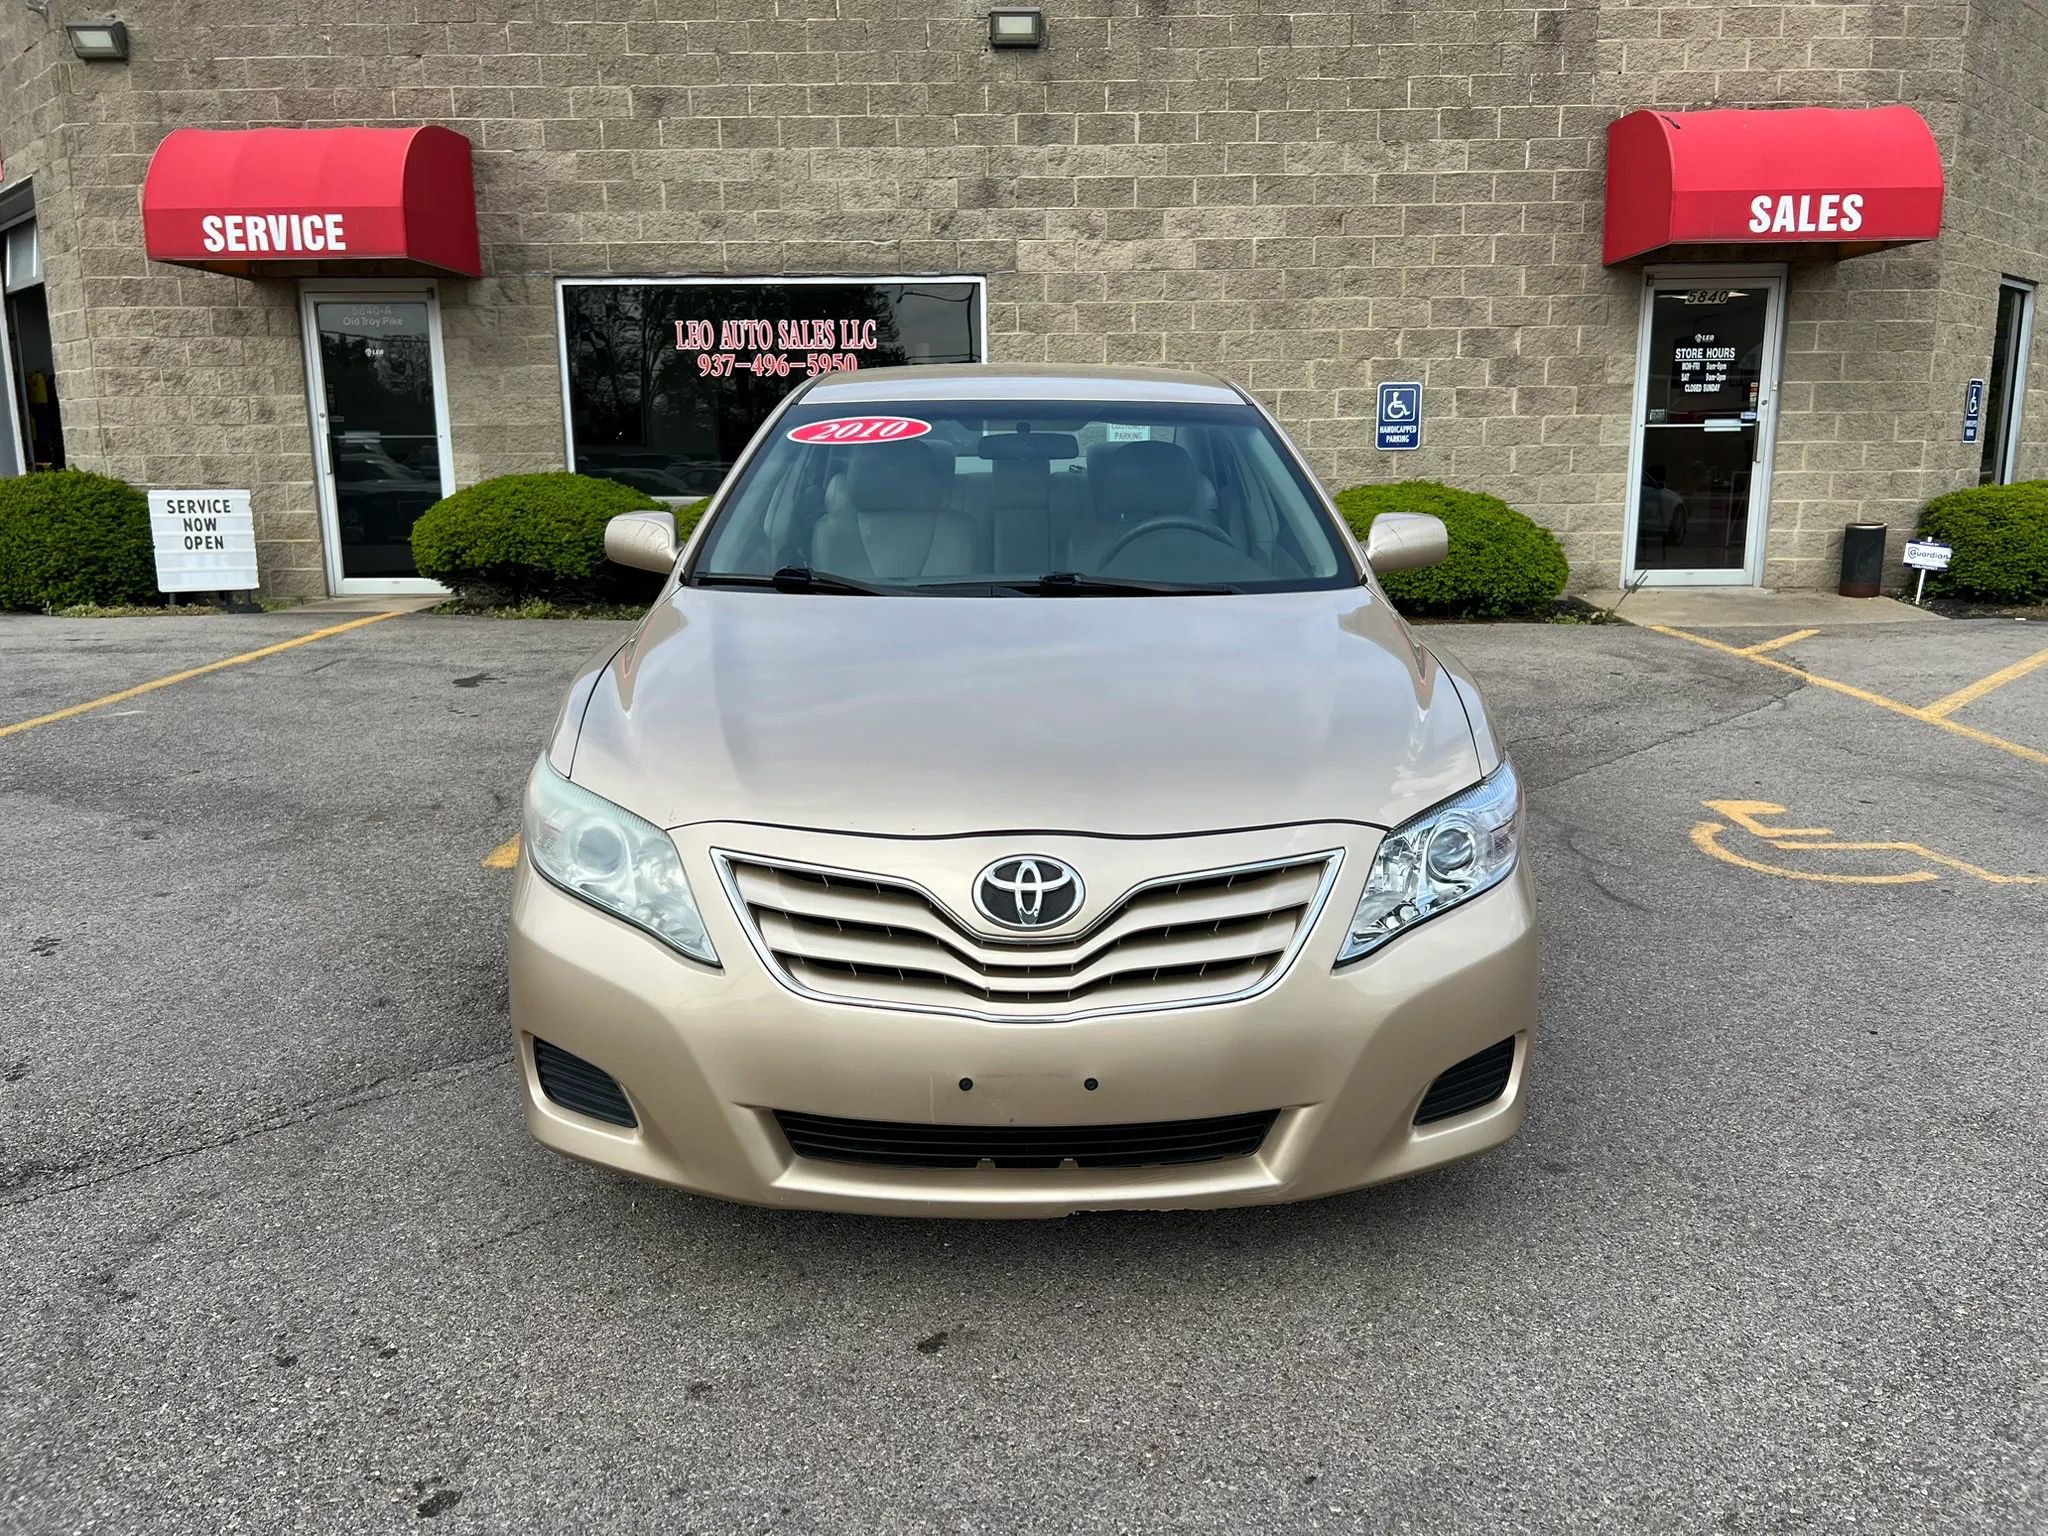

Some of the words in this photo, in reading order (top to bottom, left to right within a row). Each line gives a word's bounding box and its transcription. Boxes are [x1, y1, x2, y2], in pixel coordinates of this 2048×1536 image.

[1749, 194, 1864, 233] SALES
[202, 214, 347, 252] SERVICE
[1687, 290, 1728, 303] 5840
[343, 317, 360, 326] Old
[361, 317, 381, 328] Troy
[382, 317, 403, 326] Pike
[675, 320, 714, 350] LEO
[719, 320, 773, 350] AUTO
[778, 320, 835, 350] SALES
[839, 320, 877, 350] LLC
[1675, 348, 1703, 359] STORE
[1706, 347, 1736, 358] HOURS
[697, 353, 858, 377] 937-496-5950
[1681, 373, 1690, 381] SAT
[1684, 383, 1702, 392] CLOSED
[1703, 383, 1721, 392] SUNDAY
[808, 421, 908, 440] 2010
[1114, 431, 1143, 440] PARKING
[1380, 425, 1417, 433] HANDICAPPED
[1385, 435, 1410, 443] PARKING
[167, 499, 231, 514] SERVICE
[183, 518, 217, 532] NOW
[184, 536, 224, 550] OPEN
[1908, 546, 1949, 560] Guardian
